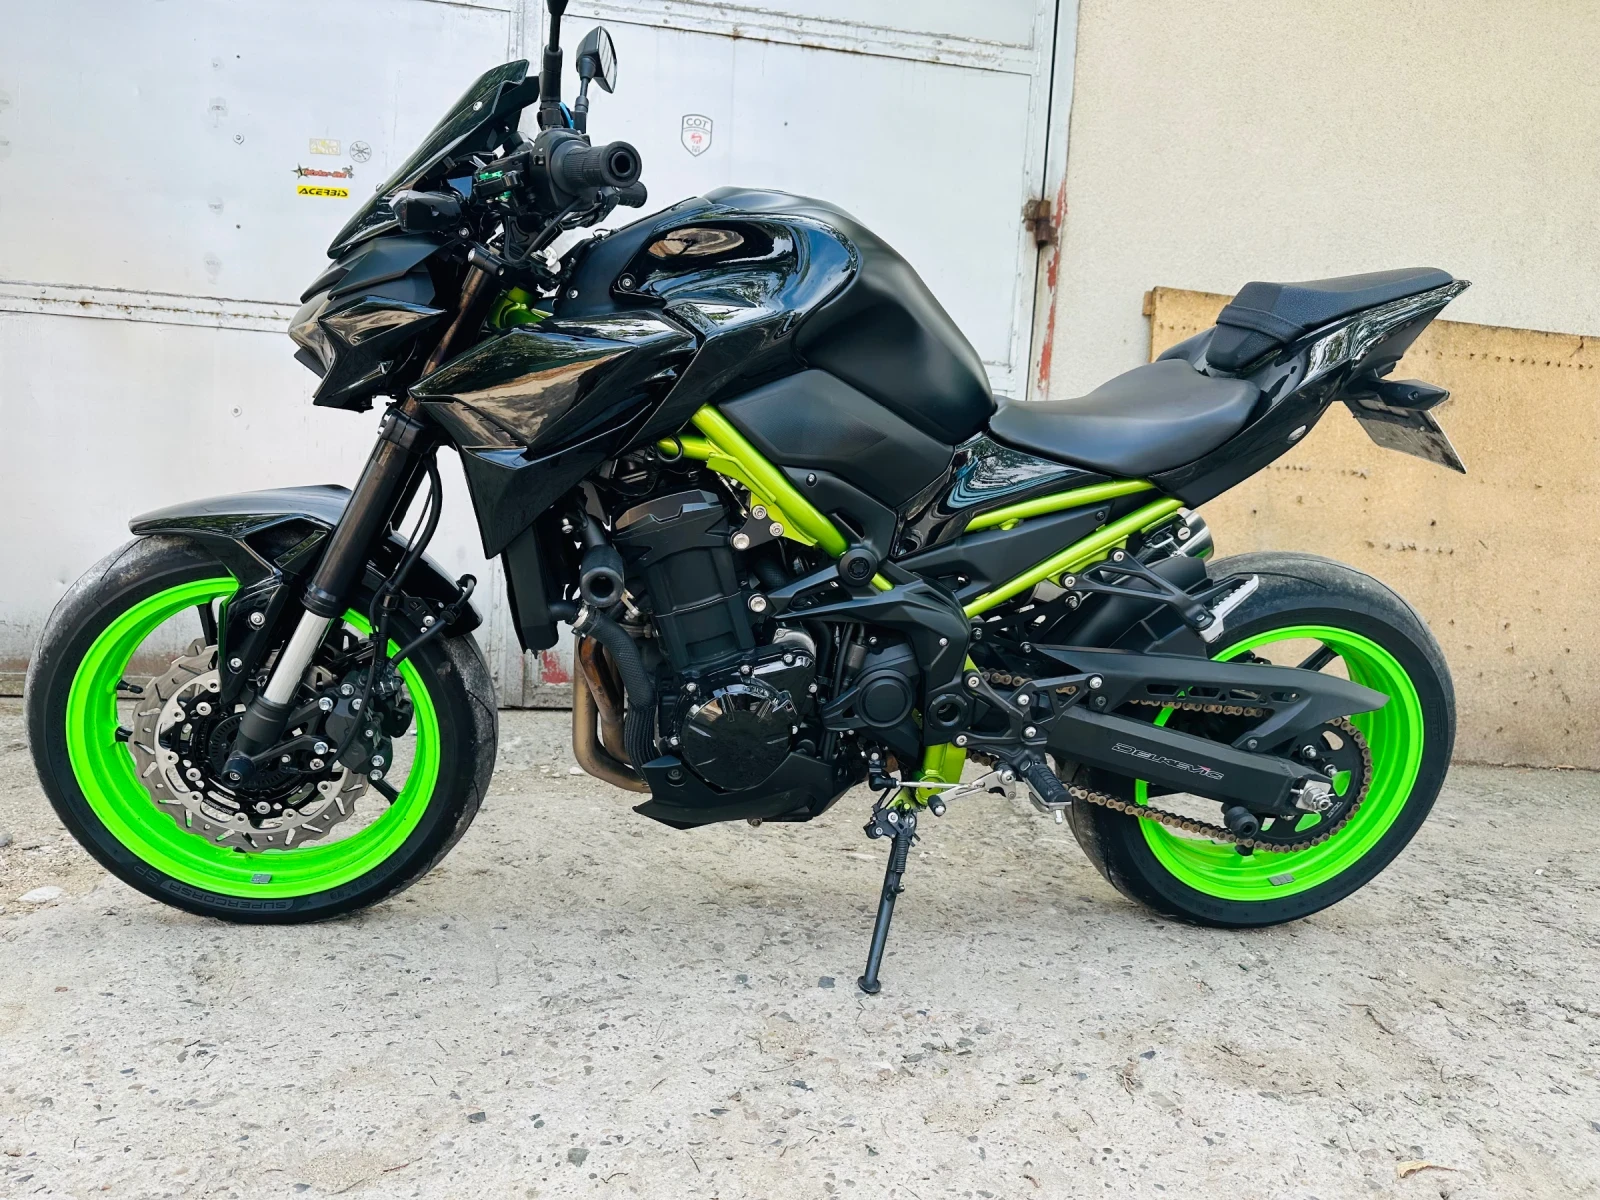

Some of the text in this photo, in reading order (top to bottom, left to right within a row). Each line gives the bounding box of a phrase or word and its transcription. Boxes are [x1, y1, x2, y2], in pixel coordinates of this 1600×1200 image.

[686, 118, 709, 129] COT
[133, 865, 161, 883] SP
[169, 882, 288, 910] SUPERCORSA
